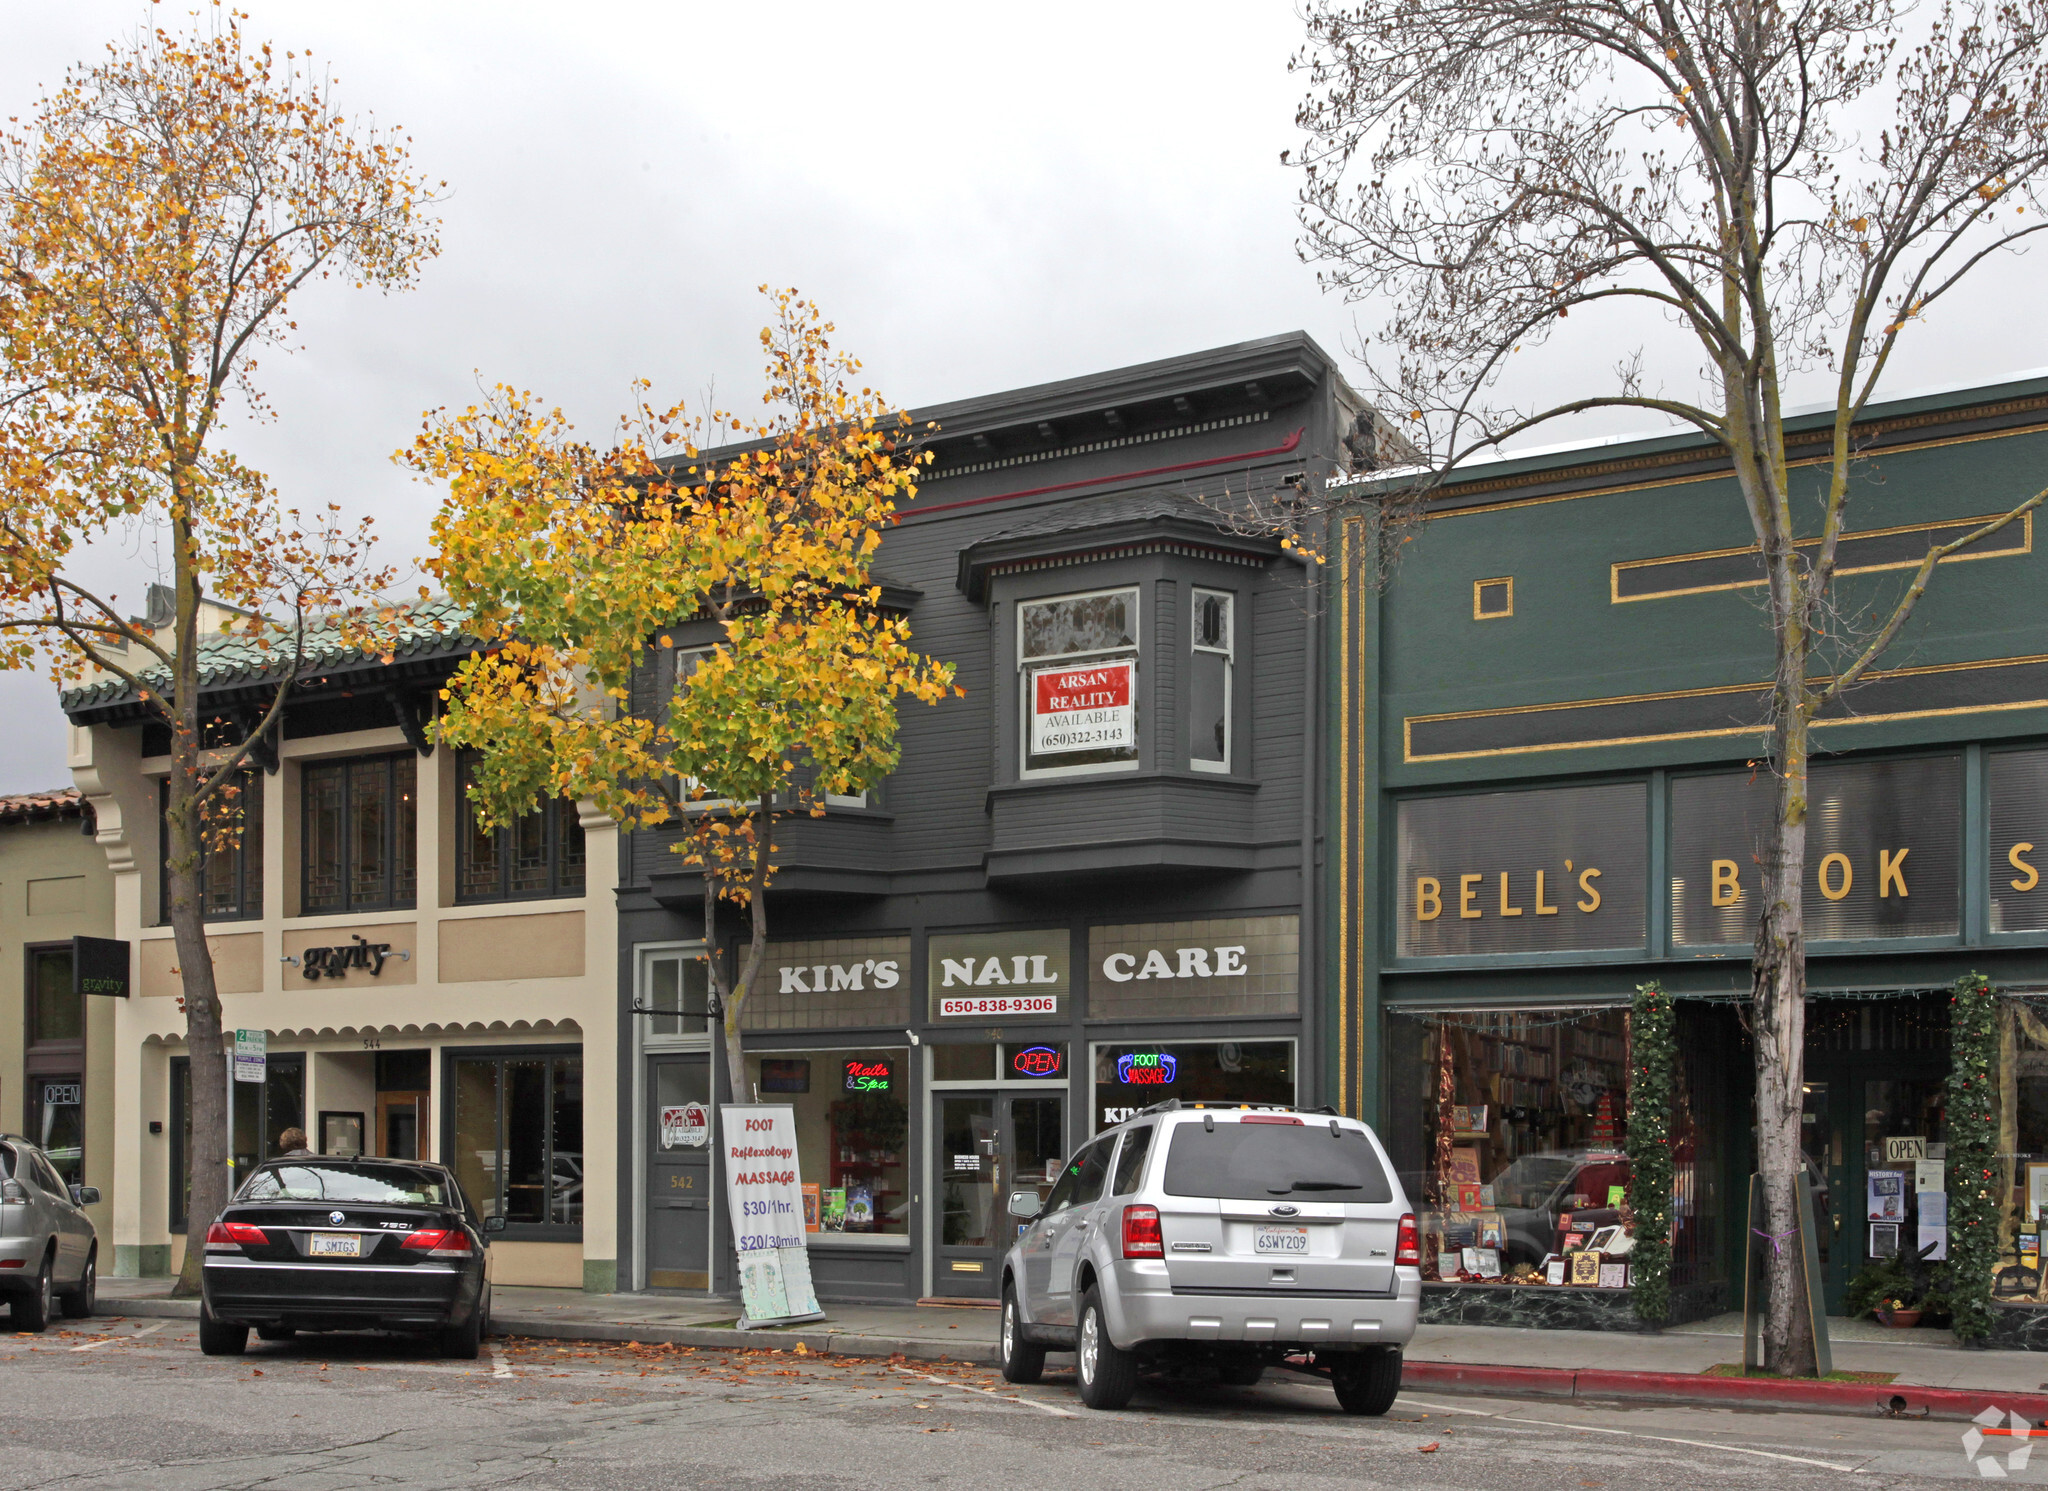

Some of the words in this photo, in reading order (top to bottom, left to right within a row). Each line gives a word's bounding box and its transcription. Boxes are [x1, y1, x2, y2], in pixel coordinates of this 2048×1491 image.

[1057, 672, 1108, 689] ARSAN
[1049, 691, 1117, 710] REALITY
[1045, 710, 1120, 728] AVAILABLE
[1041, 728, 1123, 749] (650)322-3143
[1416, 859, 1602, 921] BELL'S
[1711, 848, 1910, 907] BOK
[778, 959, 900, 994] KIM'S
[941, 955, 1058, 987] NAIL
[1102, 945, 1248, 983] CARE
[944, 998, 1053, 1013] 650-838-9306
[239, 1031, 245, 1041] 2
[363, 1039, 381, 1050] 544
[1014, 1052, 1061, 1072] OPEN
[1134, 1054, 1159, 1067] FOOT
[846, 1062, 889, 1077] Nails
[1128, 1068, 1166, 1084] MASSAGE
[46, 1086, 79, 1104] OPEN
[745, 1119, 773, 1131] FOOT
[731, 1145, 793, 1160] Reflexology
[1889, 1140, 1923, 1160] OPEN
[671, 1176, 693, 1189] 542
[735, 1171, 795, 1186] MASSAGE
[743, 1200, 794, 1217] $30/1hr.
[313, 1240, 320, 1251] T
[325, 1241, 355, 1254] SMIGS
[740, 1234, 803, 1251] $20/30min.
[1258, 1235, 1306, 1250] 6SWY209
